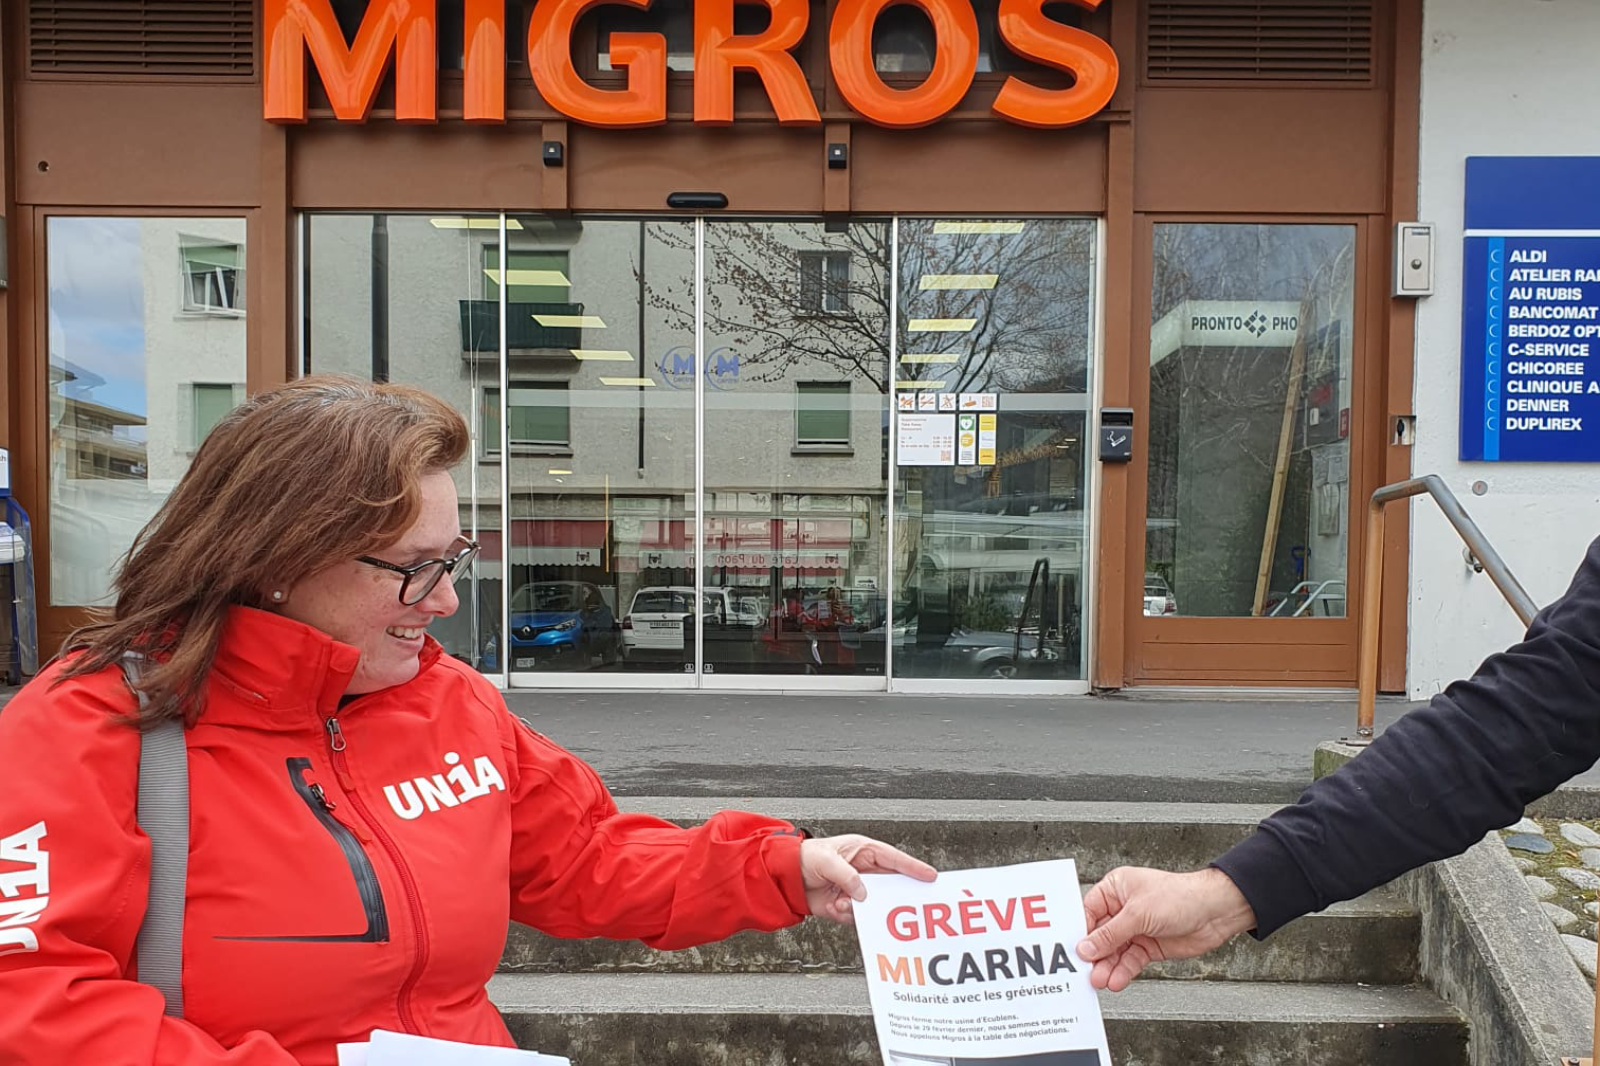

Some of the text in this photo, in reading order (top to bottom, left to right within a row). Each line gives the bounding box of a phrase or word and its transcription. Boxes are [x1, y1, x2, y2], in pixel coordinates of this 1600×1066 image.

[262, 0, 1119, 129] MIGROS
[1509, 250, 1547, 263] ALDI
[1509, 269, 1571, 282] ATELIER
[1509, 288, 1582, 301] AU RUBIS
[1508, 306, 1599, 319] BANCOMAT
[1191, 316, 1243, 331] PRONTO
[1508, 325, 1570, 338] BERDOZ
[1508, 343, 1590, 356] C-SERVICE
[1507, 362, 1584, 375] CHICOREE
[1507, 381, 1583, 394] CLINIQUE
[1506, 399, 1569, 412] DENNER
[1506, 418, 1582, 431] DUPLIREX
[886, 889, 1051, 942] GRÈVE
[877, 942, 1078, 986] MICARNA
[893, 982, 1071, 1005] Solidarité avec les grévistes !
[1008, 1021, 1040, 1029] sommes
[1053, 1017, 1074, 1025] grève
[983, 1033, 1002, 1041] table
[1019, 1026, 1070, 1038] négociations.
